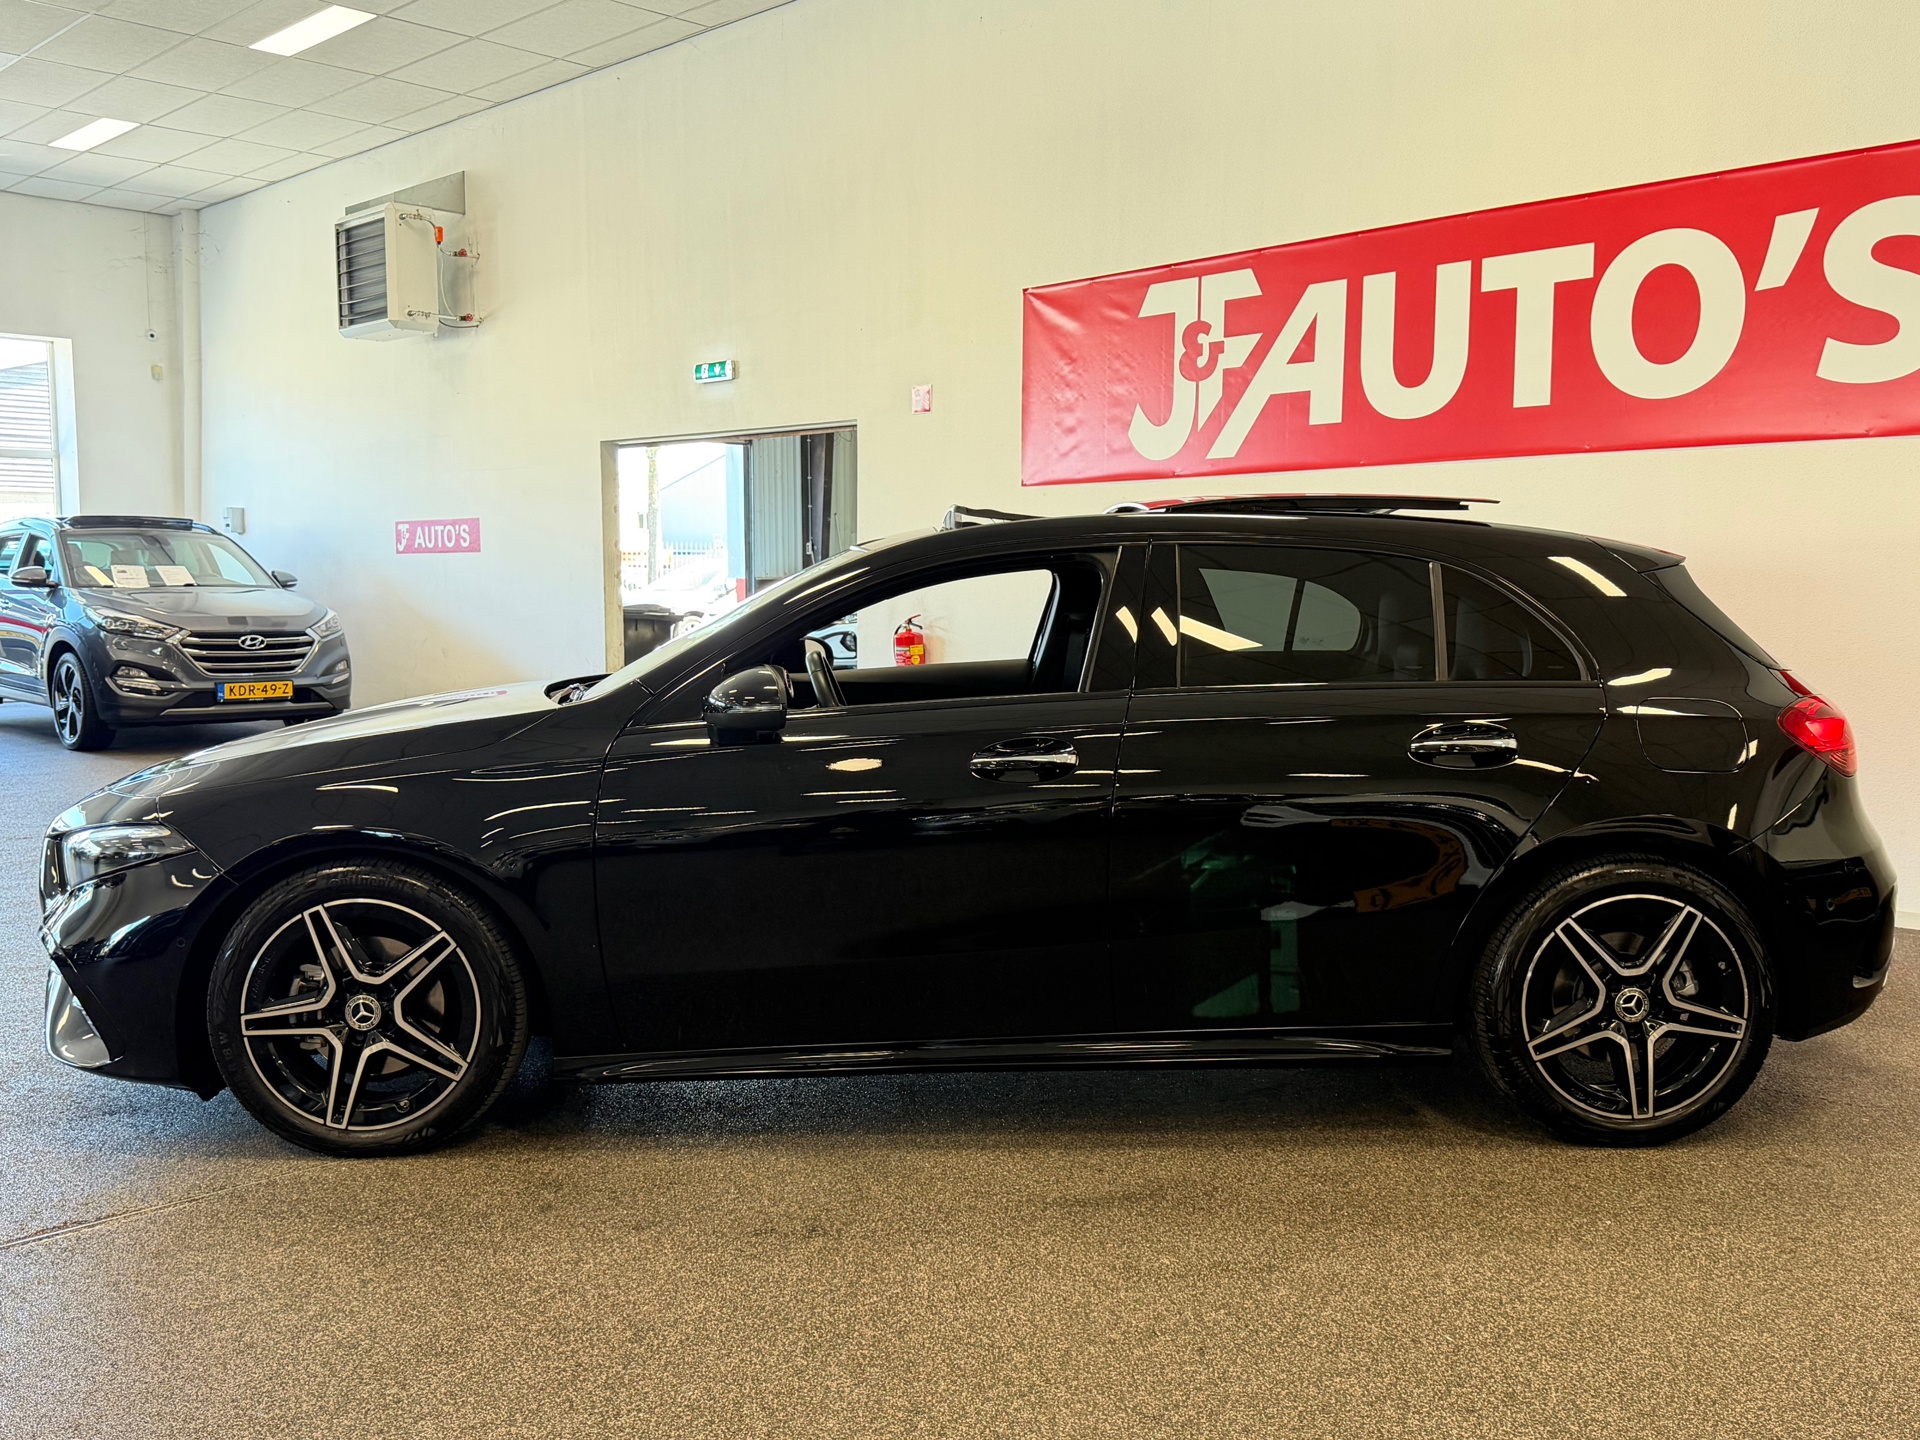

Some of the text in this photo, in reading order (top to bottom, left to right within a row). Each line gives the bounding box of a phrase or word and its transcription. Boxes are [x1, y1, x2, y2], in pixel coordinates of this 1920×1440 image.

[1206, 194, 1920, 459] AUTO'S
[414, 524, 470, 549] AUTO'S
[229, 683, 289, 697] KDR-49-Z
